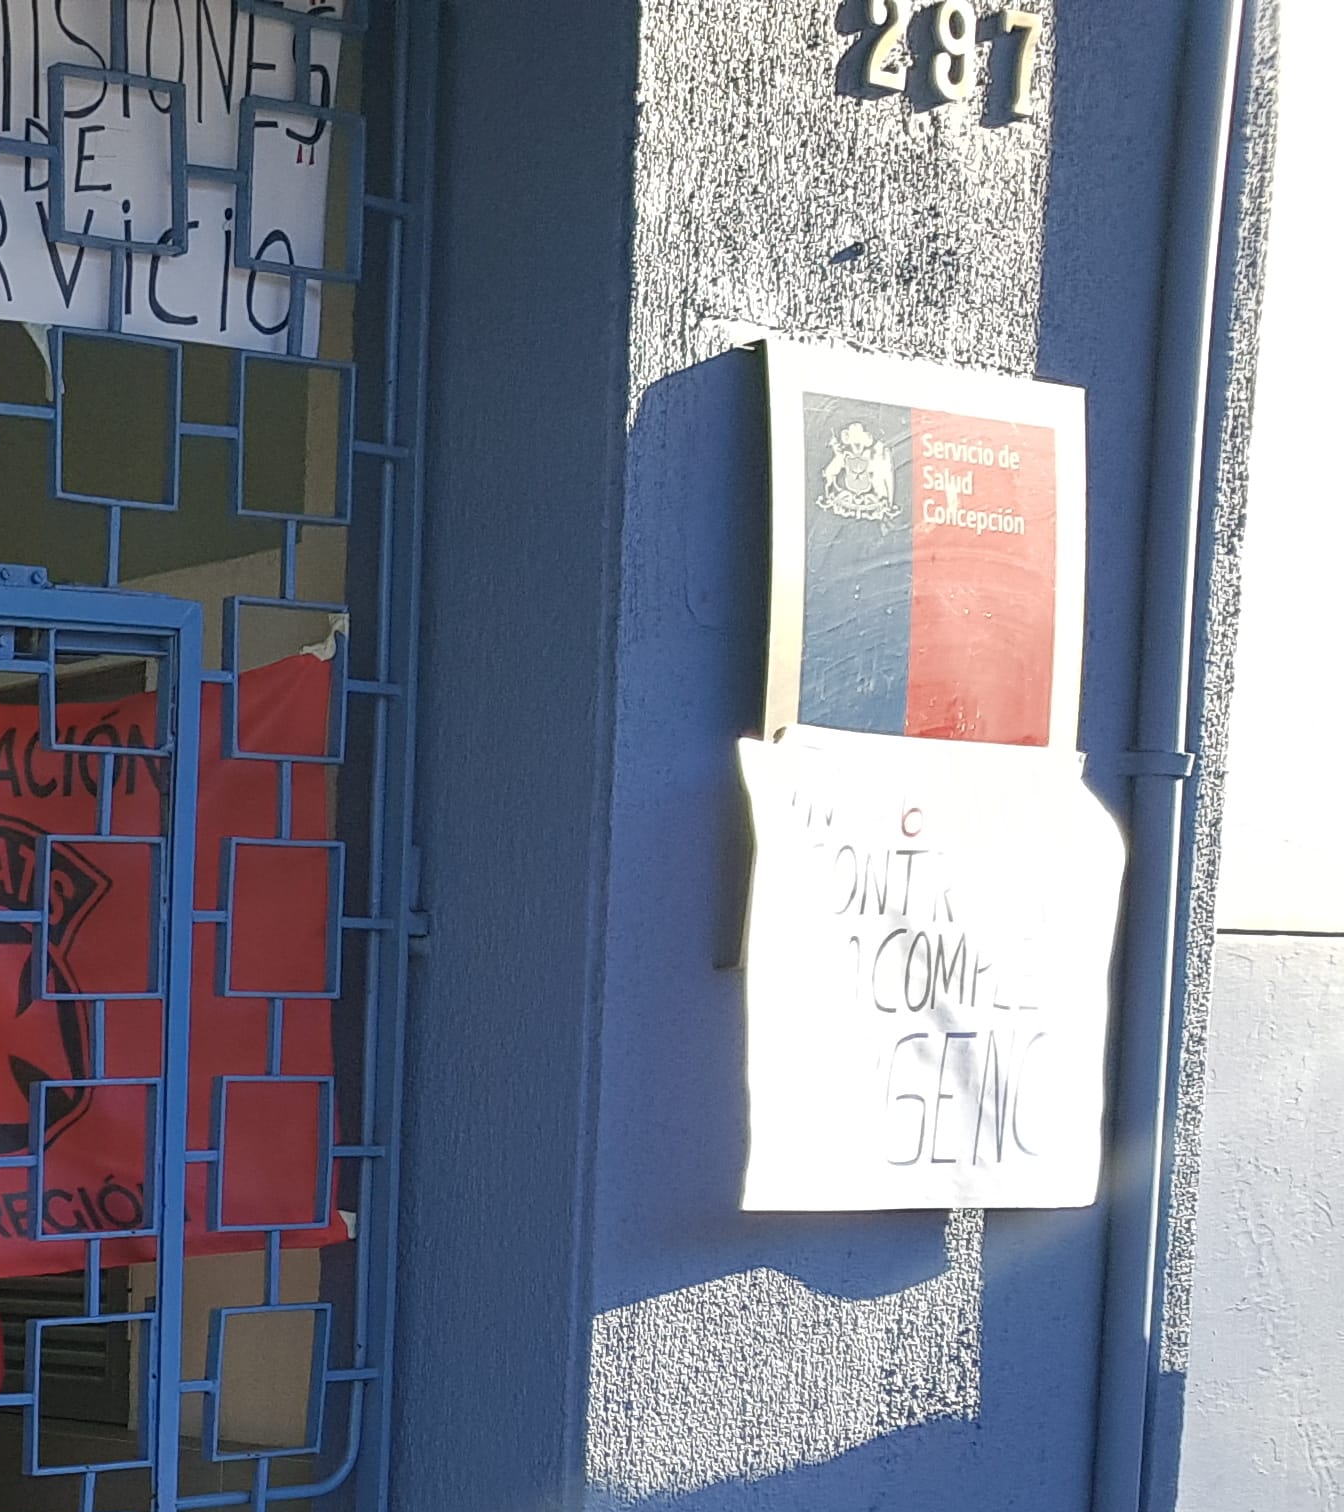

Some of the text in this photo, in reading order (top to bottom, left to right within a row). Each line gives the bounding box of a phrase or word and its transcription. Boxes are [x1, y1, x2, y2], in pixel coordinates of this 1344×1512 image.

[868, 0, 1042, 116] 297
[25, 117, 112, 192] DE
[921, 434, 1020, 471] Servicio de
[922, 465, 974, 496] Salud
[922, 499, 1026, 536] Concepción
